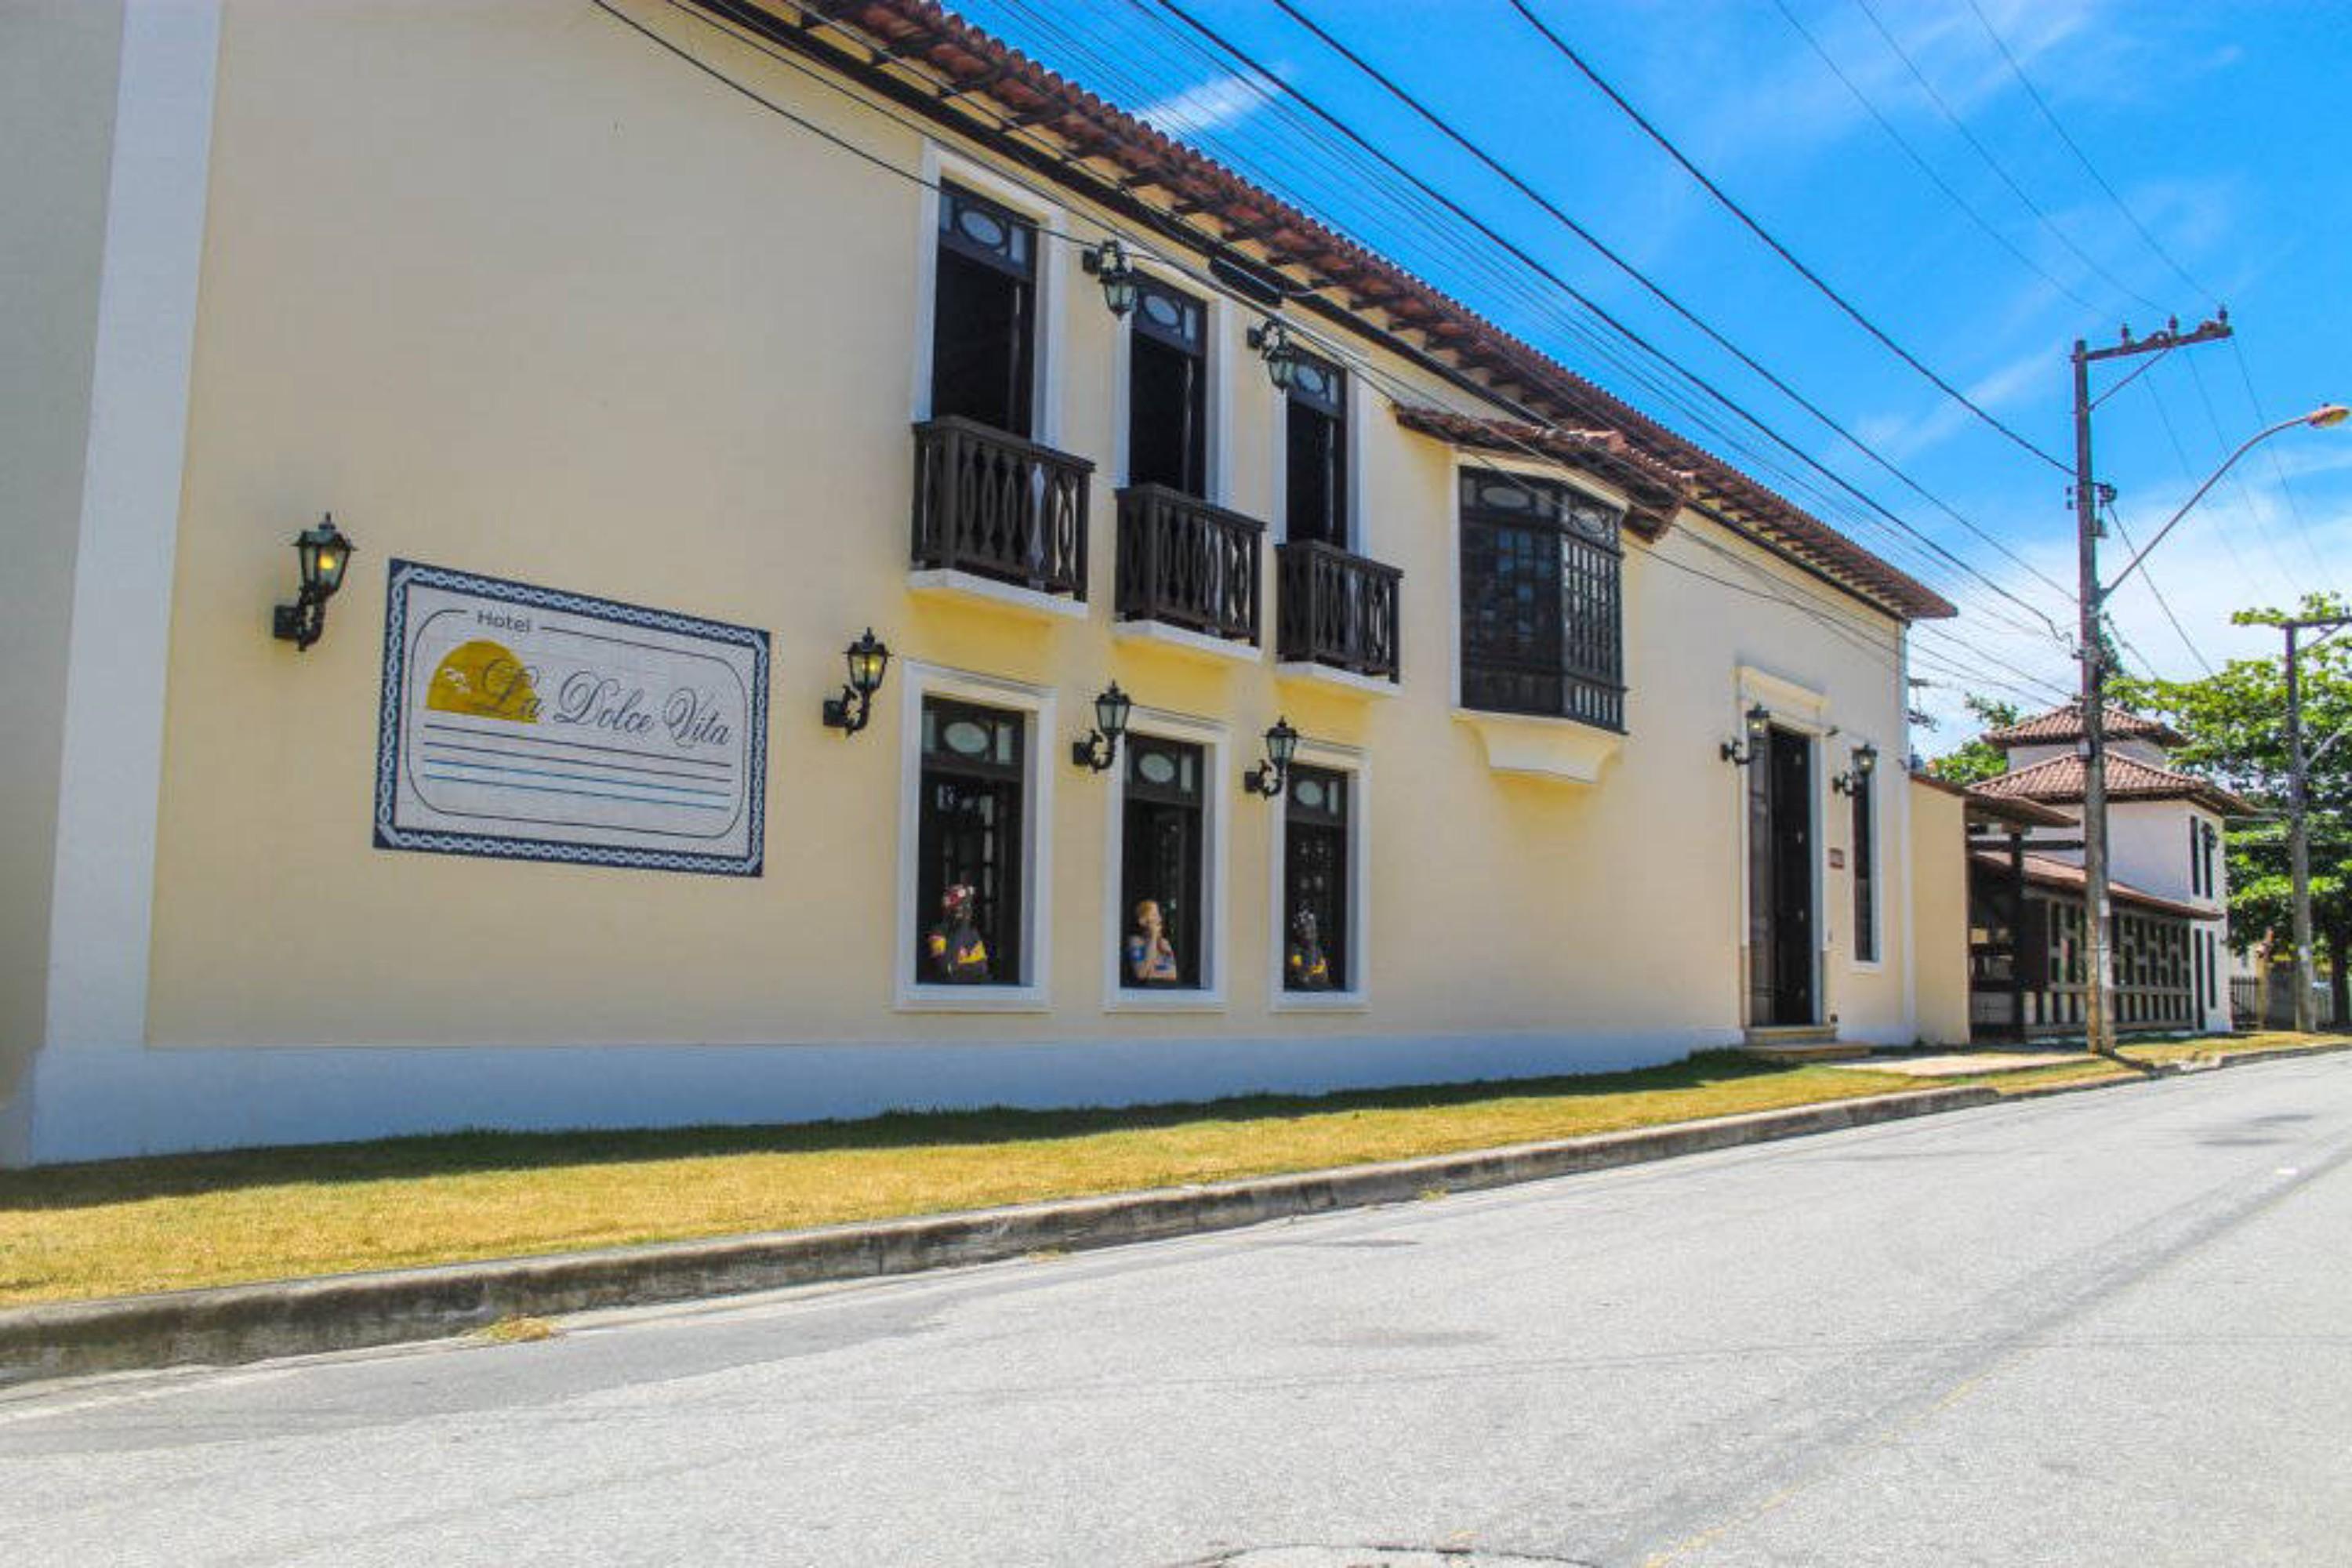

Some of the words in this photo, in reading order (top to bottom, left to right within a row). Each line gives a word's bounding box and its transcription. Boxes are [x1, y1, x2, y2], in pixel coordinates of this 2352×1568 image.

[477, 609, 532, 633] Hotel
[553, 670, 655, 734] Dolce
[662, 687, 731, 748] Vita
